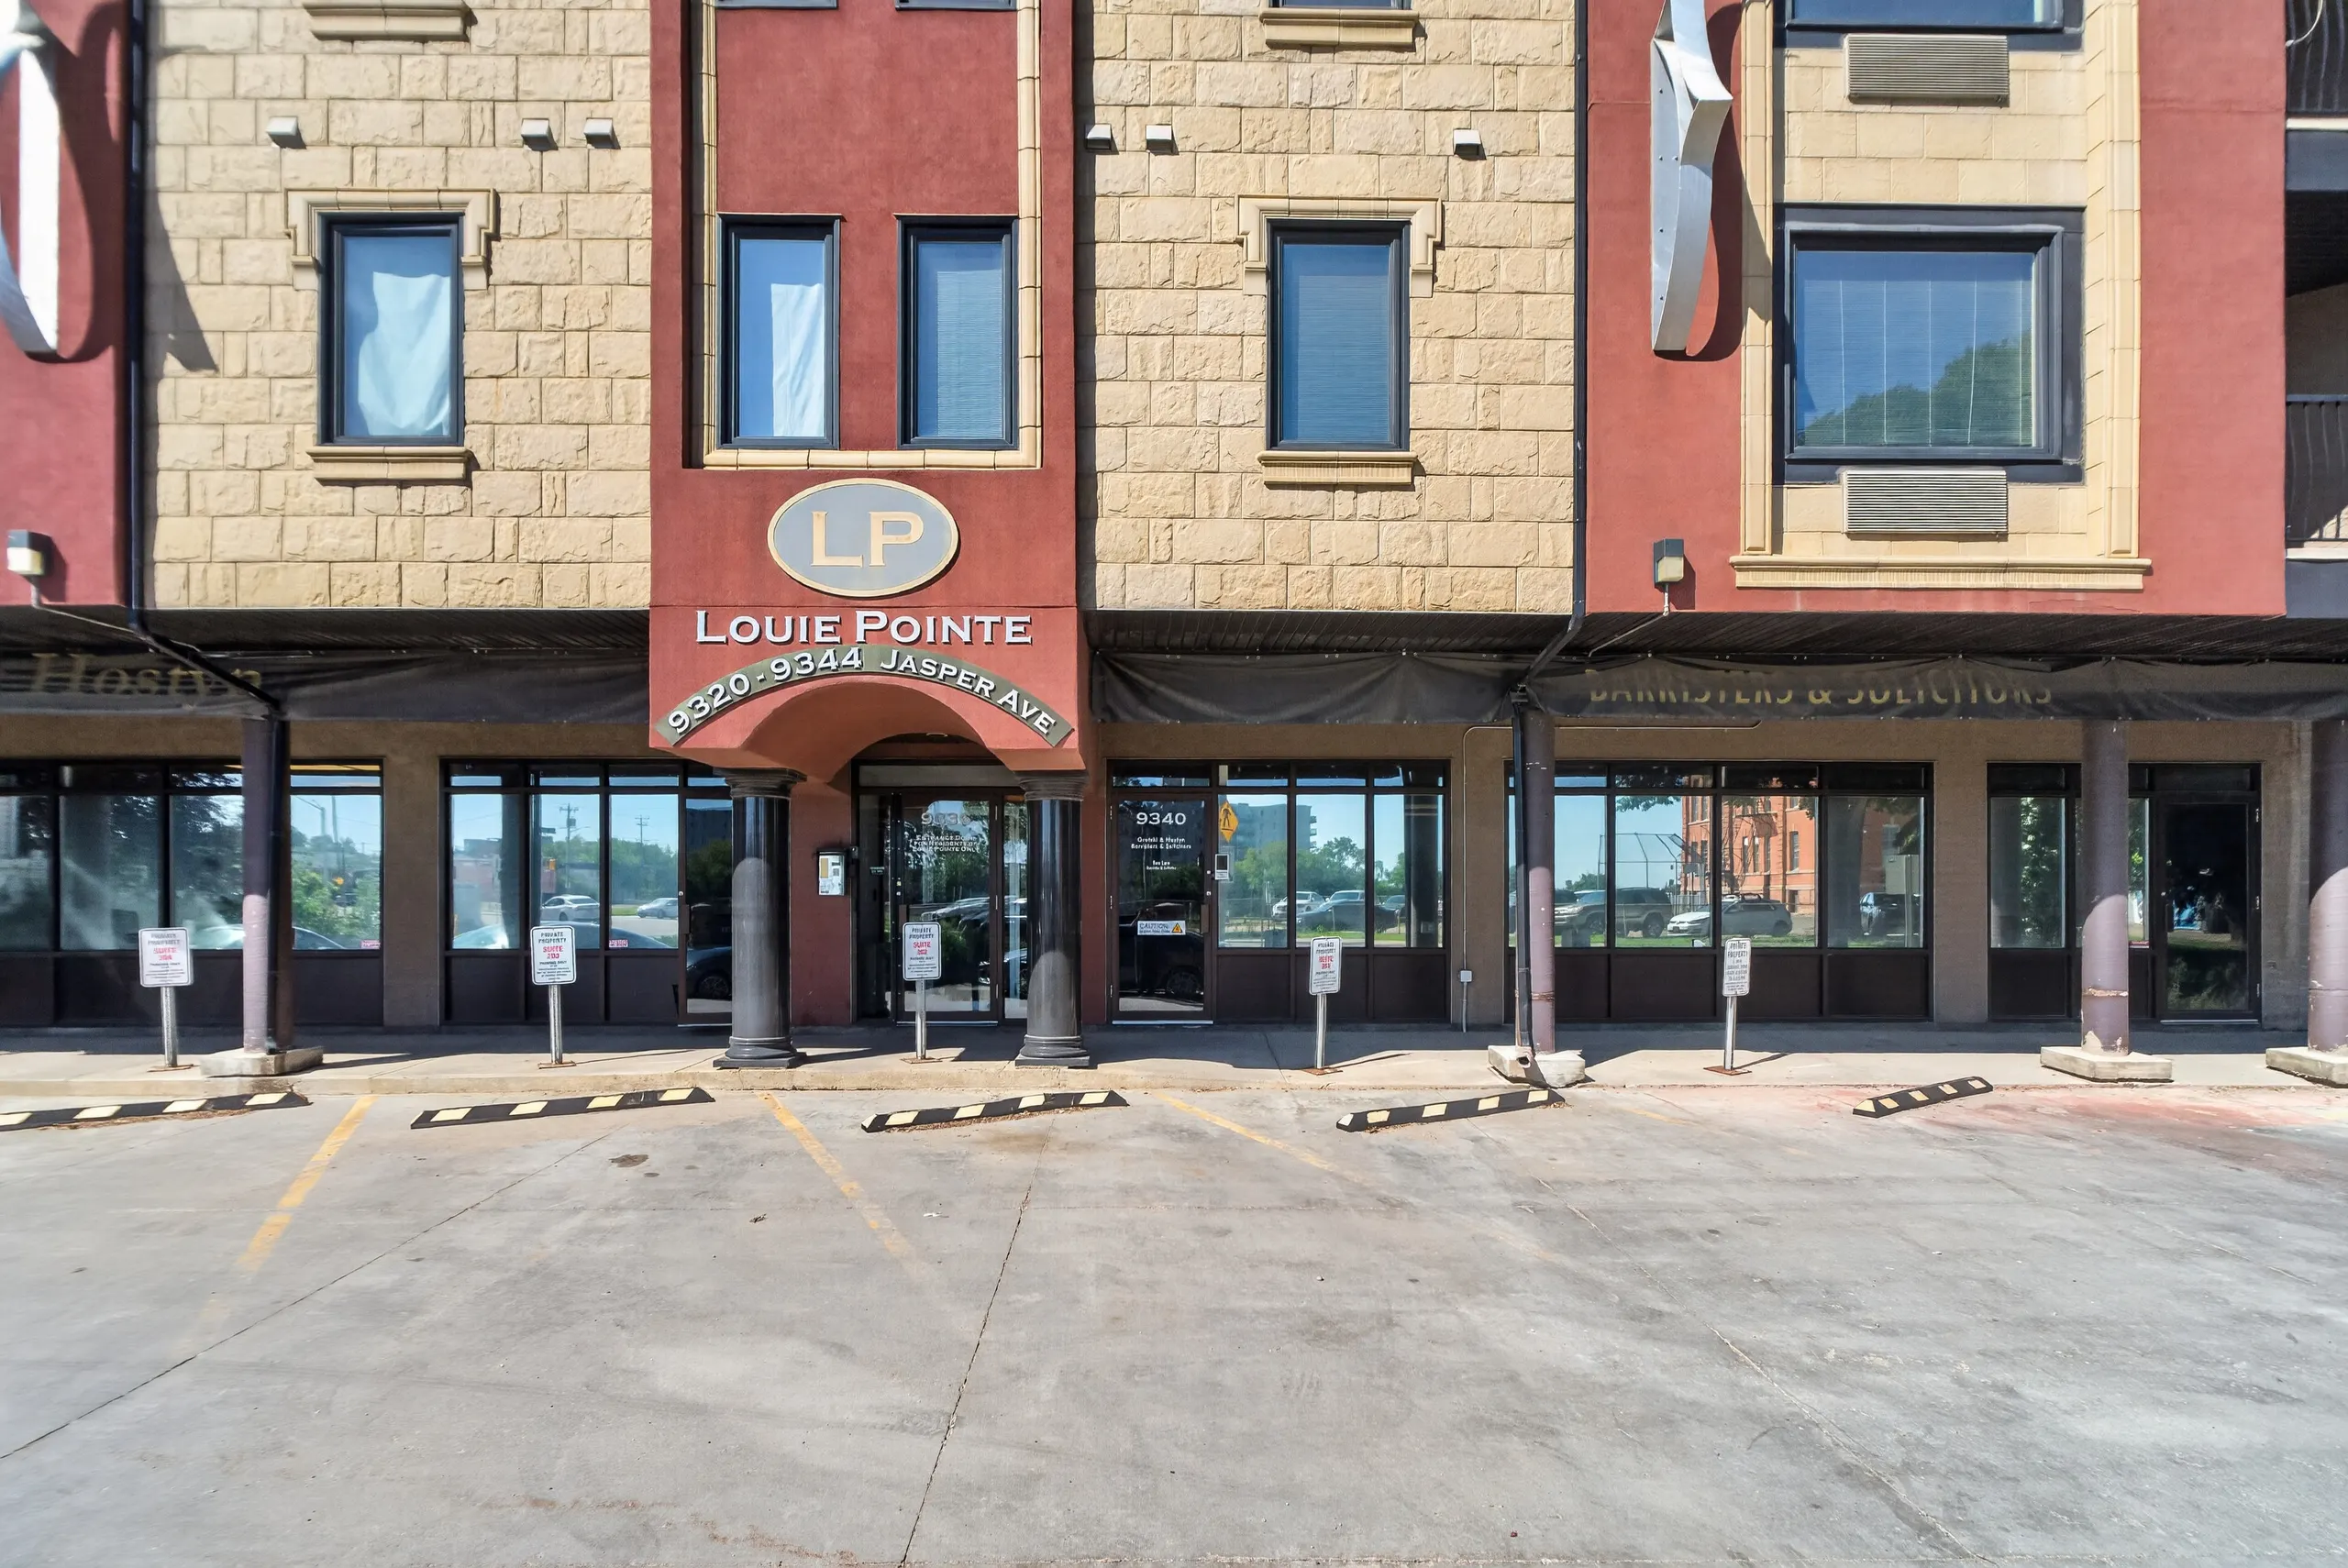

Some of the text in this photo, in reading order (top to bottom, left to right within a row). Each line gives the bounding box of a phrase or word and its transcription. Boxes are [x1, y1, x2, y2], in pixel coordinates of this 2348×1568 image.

[811, 510, 925, 568] LP
[696, 610, 1033, 645] LOUIE POINTE
[880, 649, 996, 699] JASPER
[997, 689, 1057, 734] AVE
[1136, 812, 1187, 825] 9340
